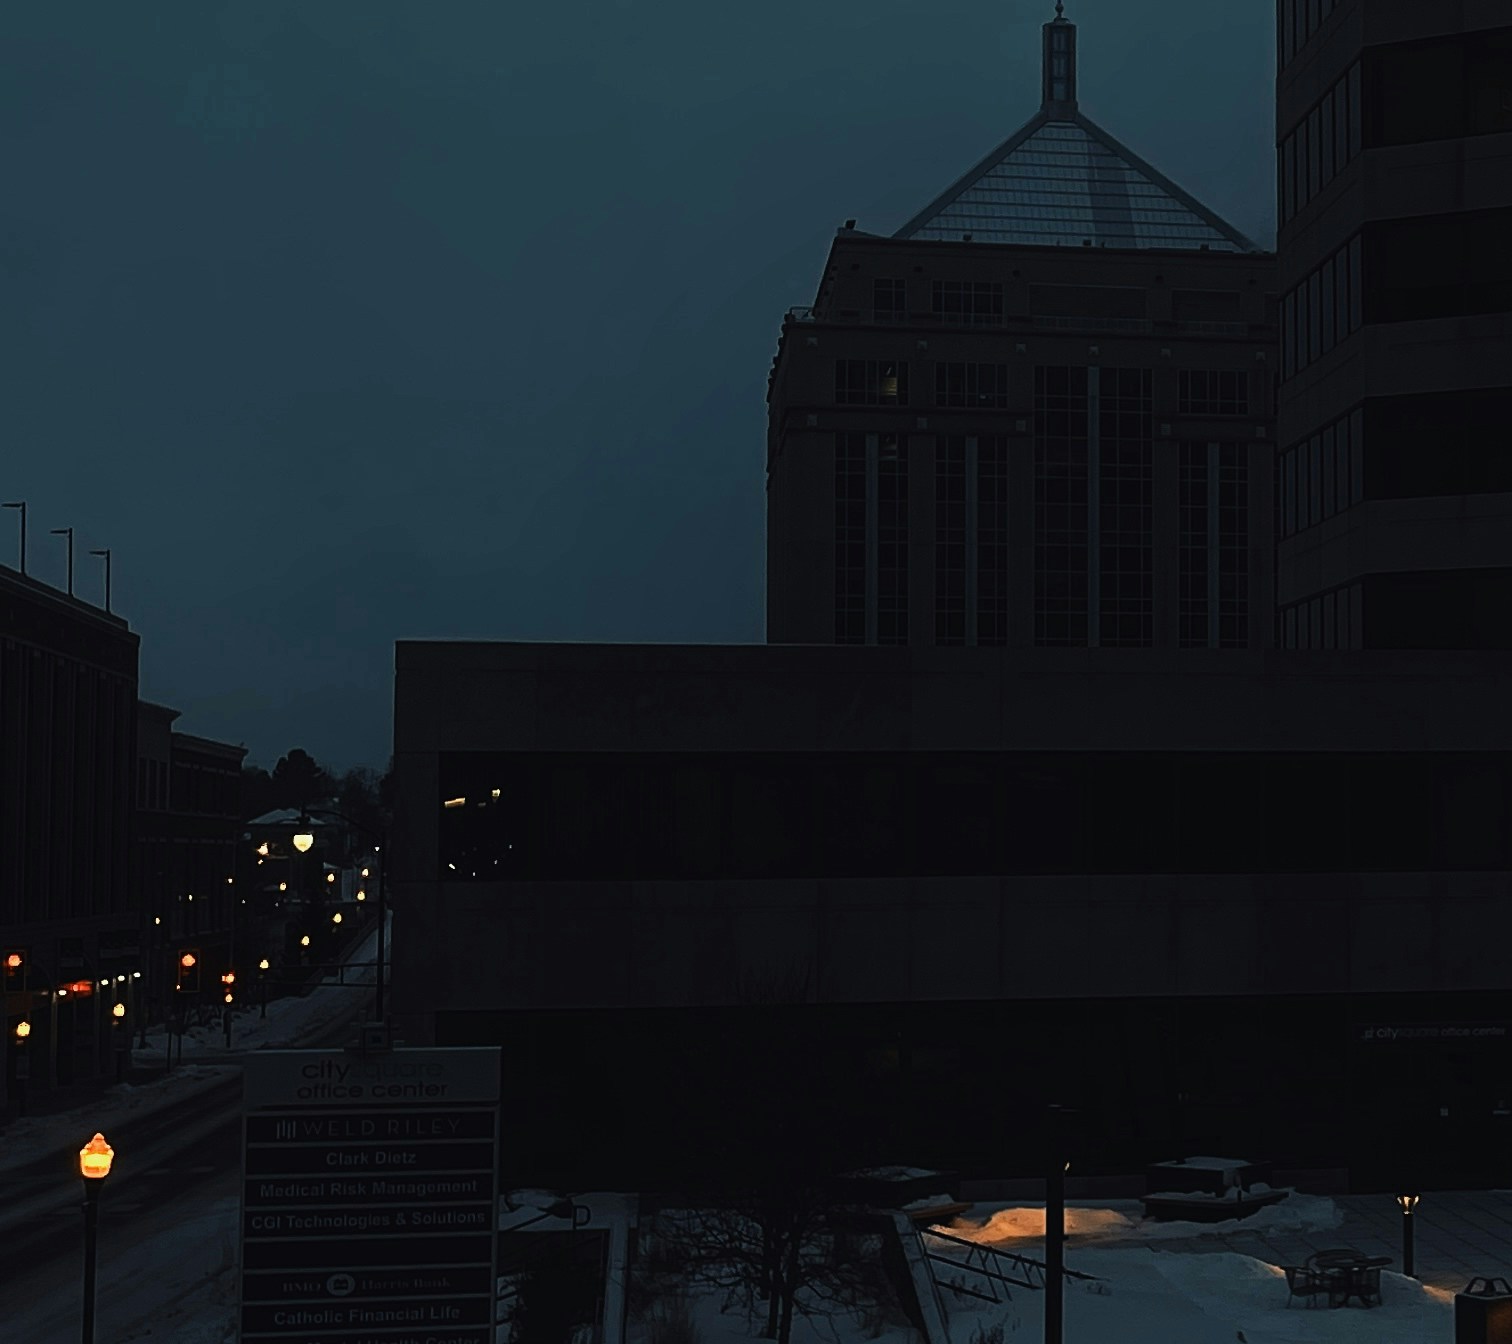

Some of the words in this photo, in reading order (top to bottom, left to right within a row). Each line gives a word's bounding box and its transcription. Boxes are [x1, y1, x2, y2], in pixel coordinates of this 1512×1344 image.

[297, 1083, 363, 1099] office
[371, 1081, 448, 1098] center
[303, 1119, 375, 1136] WELD
[387, 1118, 461, 1135] RILEY
[326, 1152, 369, 1166] Clark
[375, 1150, 417, 1164] Dietz
[260, 1182, 324, 1198] Medical
[330, 1181, 366, 1196] Risk
[372, 1180, 478, 1197] Management
[252, 1216, 281, 1229] CGI
[286, 1214, 391, 1231] Technologies
[395, 1213, 406, 1226] &
[411, 1211, 485, 1226] Solutions
[361, 1278, 409, 1290] Harris
[414, 1276, 451, 1289] Bank
[274, 1310, 344, 1325] Catholic
[349, 1307, 424, 1323] Financial
[430, 1305, 461, 1320] Life
